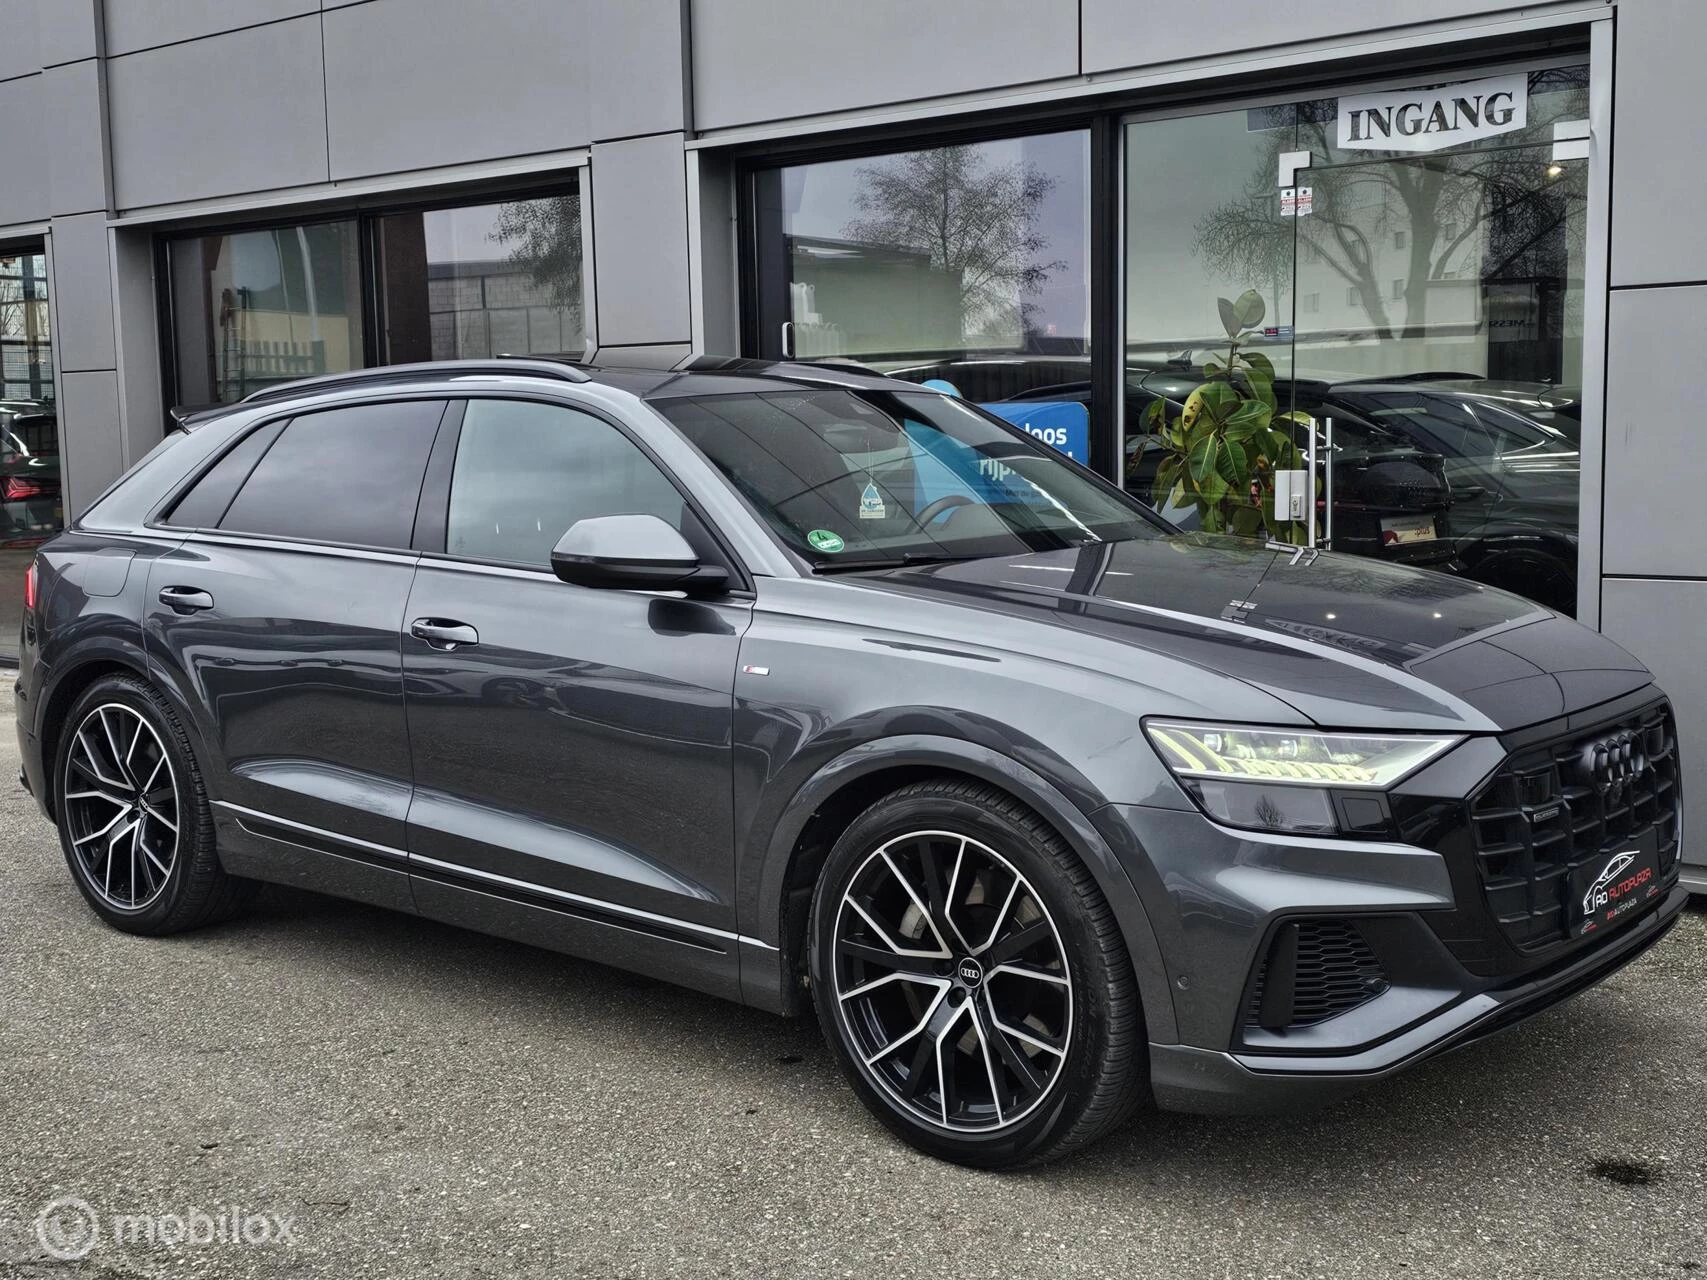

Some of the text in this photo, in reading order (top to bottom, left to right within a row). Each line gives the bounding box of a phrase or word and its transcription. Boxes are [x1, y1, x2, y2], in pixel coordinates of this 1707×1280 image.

[1348, 92, 1515, 142] INGANG
[980, 459, 1016, 481] rijp
[1609, 867, 1652, 900] AUTOPLAZA
